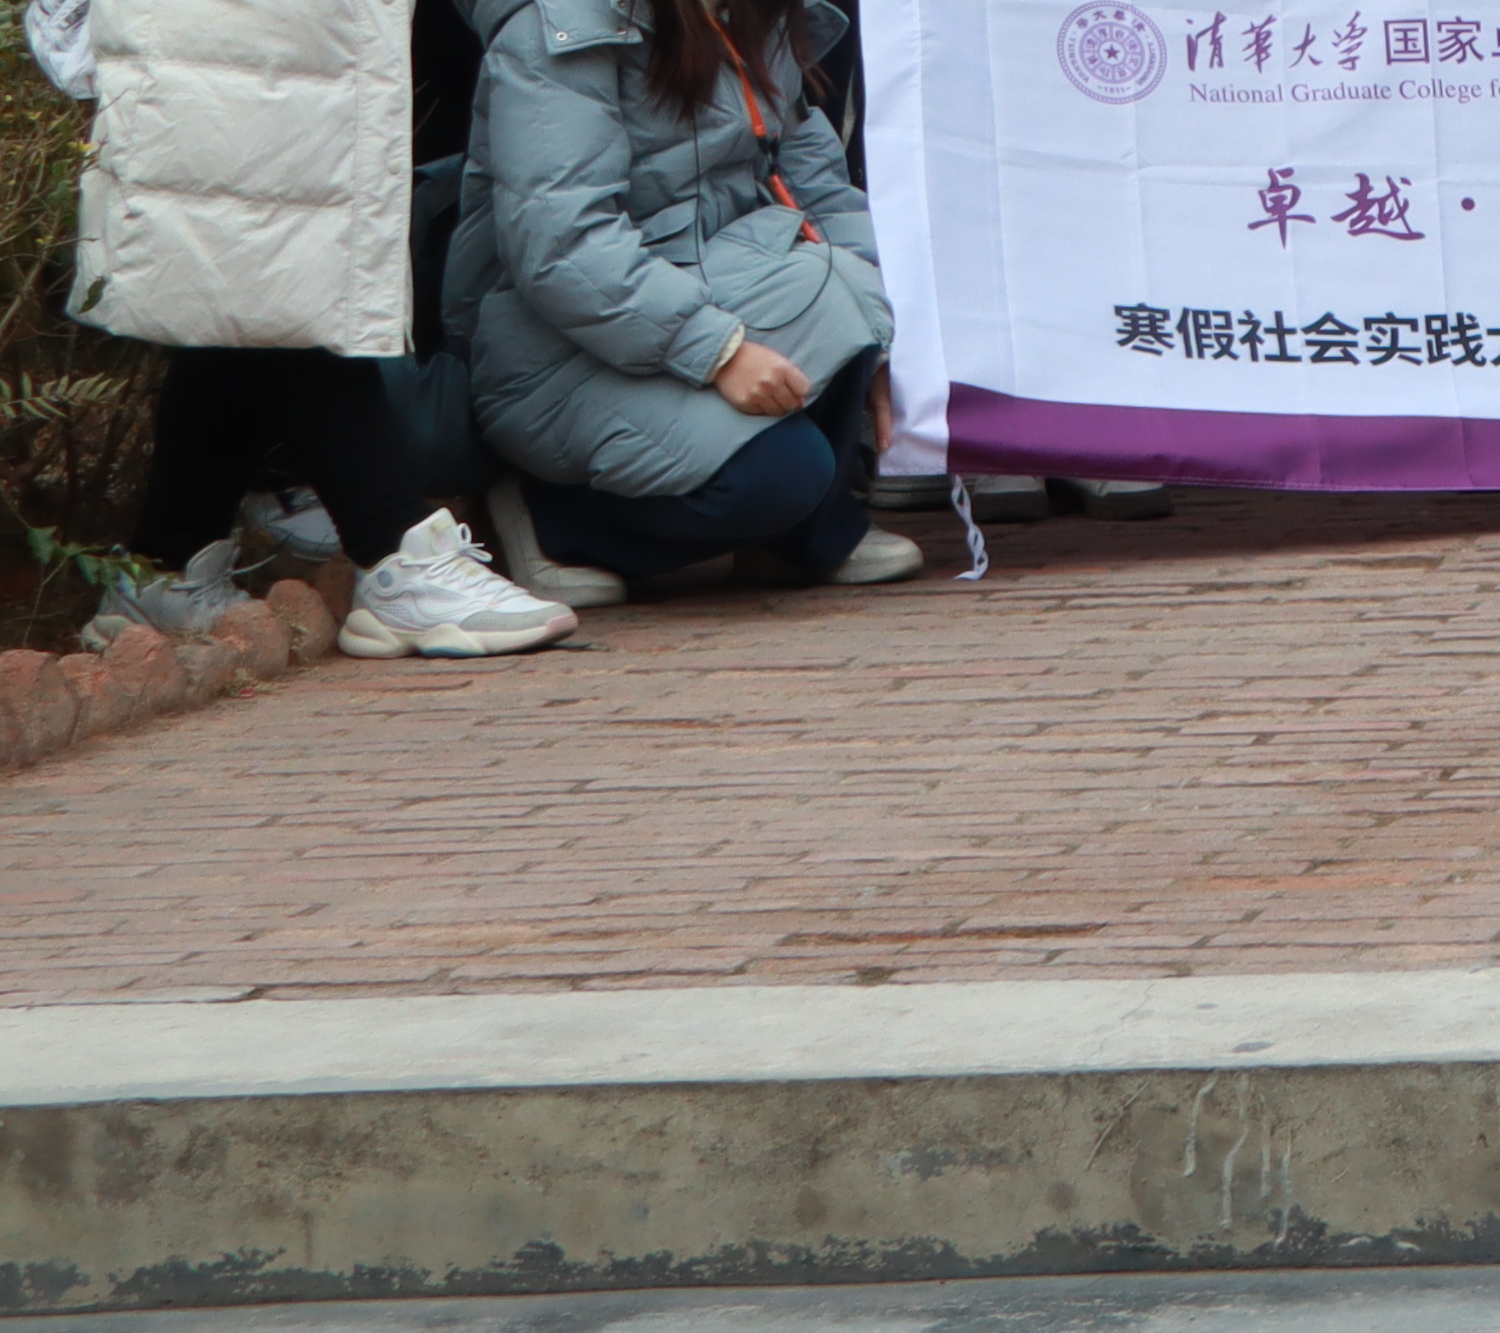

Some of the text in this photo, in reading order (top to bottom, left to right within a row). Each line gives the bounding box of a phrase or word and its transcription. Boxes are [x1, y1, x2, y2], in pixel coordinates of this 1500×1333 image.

[1188, 82, 1284, 104] National
[1291, 82, 1392, 103] Graduate
[1398, 79, 1483, 104] College
